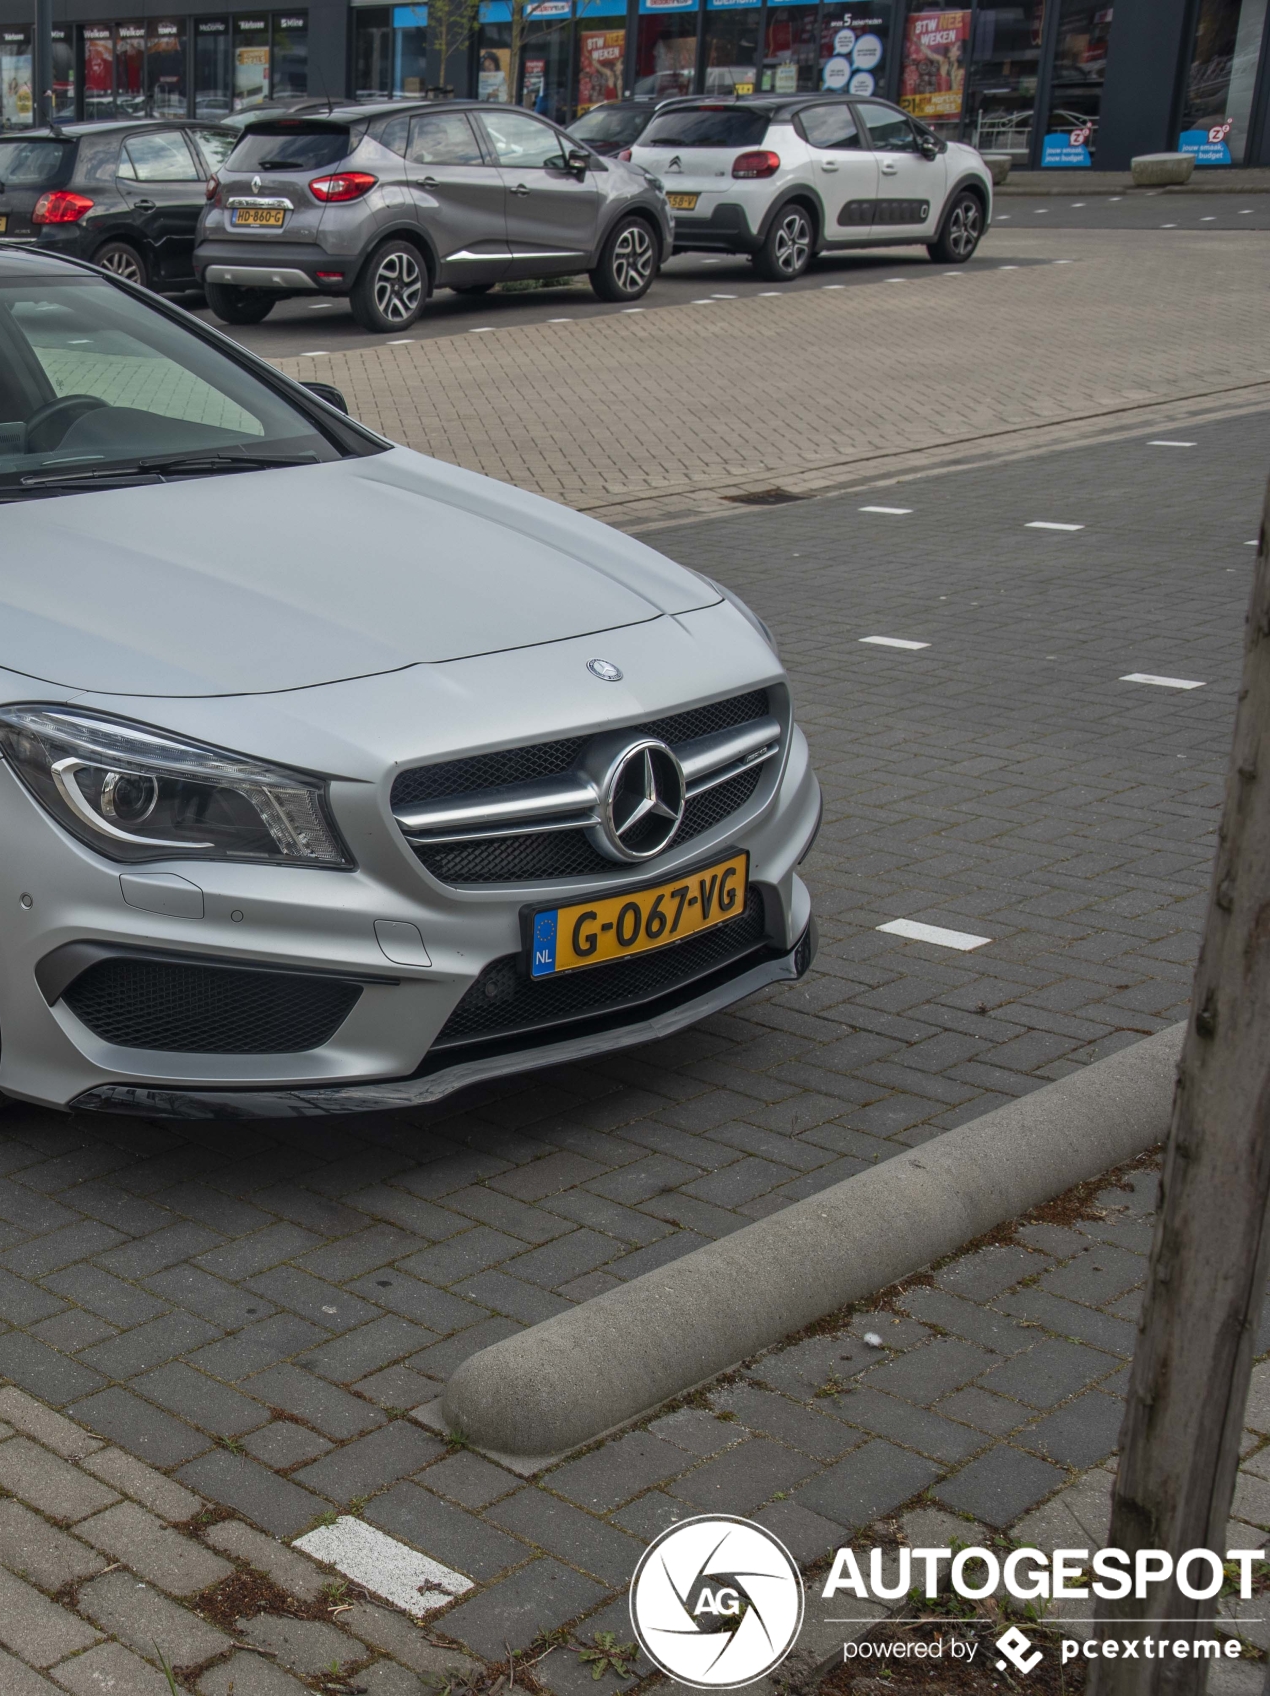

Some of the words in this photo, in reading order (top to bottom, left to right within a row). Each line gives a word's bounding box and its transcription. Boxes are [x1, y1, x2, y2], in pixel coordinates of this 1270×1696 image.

[844, 13, 852, 27] 5
[915, 18, 938, 34] BTW
[939, 12, 964, 29] NEE
[83, 28, 110, 39] Welkom
[920, 30, 956, 46] WEKEN
[587, 38, 605, 50] BTW
[606, 32, 625, 46] NEE
[592, 47, 620, 61] WEKEN
[1046, 146, 1061, 156] jouw
[1182, 144, 1199, 152] jouw
[1061, 154, 1084, 163] budget
[1198, 151, 1224, 160] budget
[237, 210, 282, 223] HD-860-G
[572, 866, 737, 957] G-067-VG
[536, 949, 553, 965] NL
